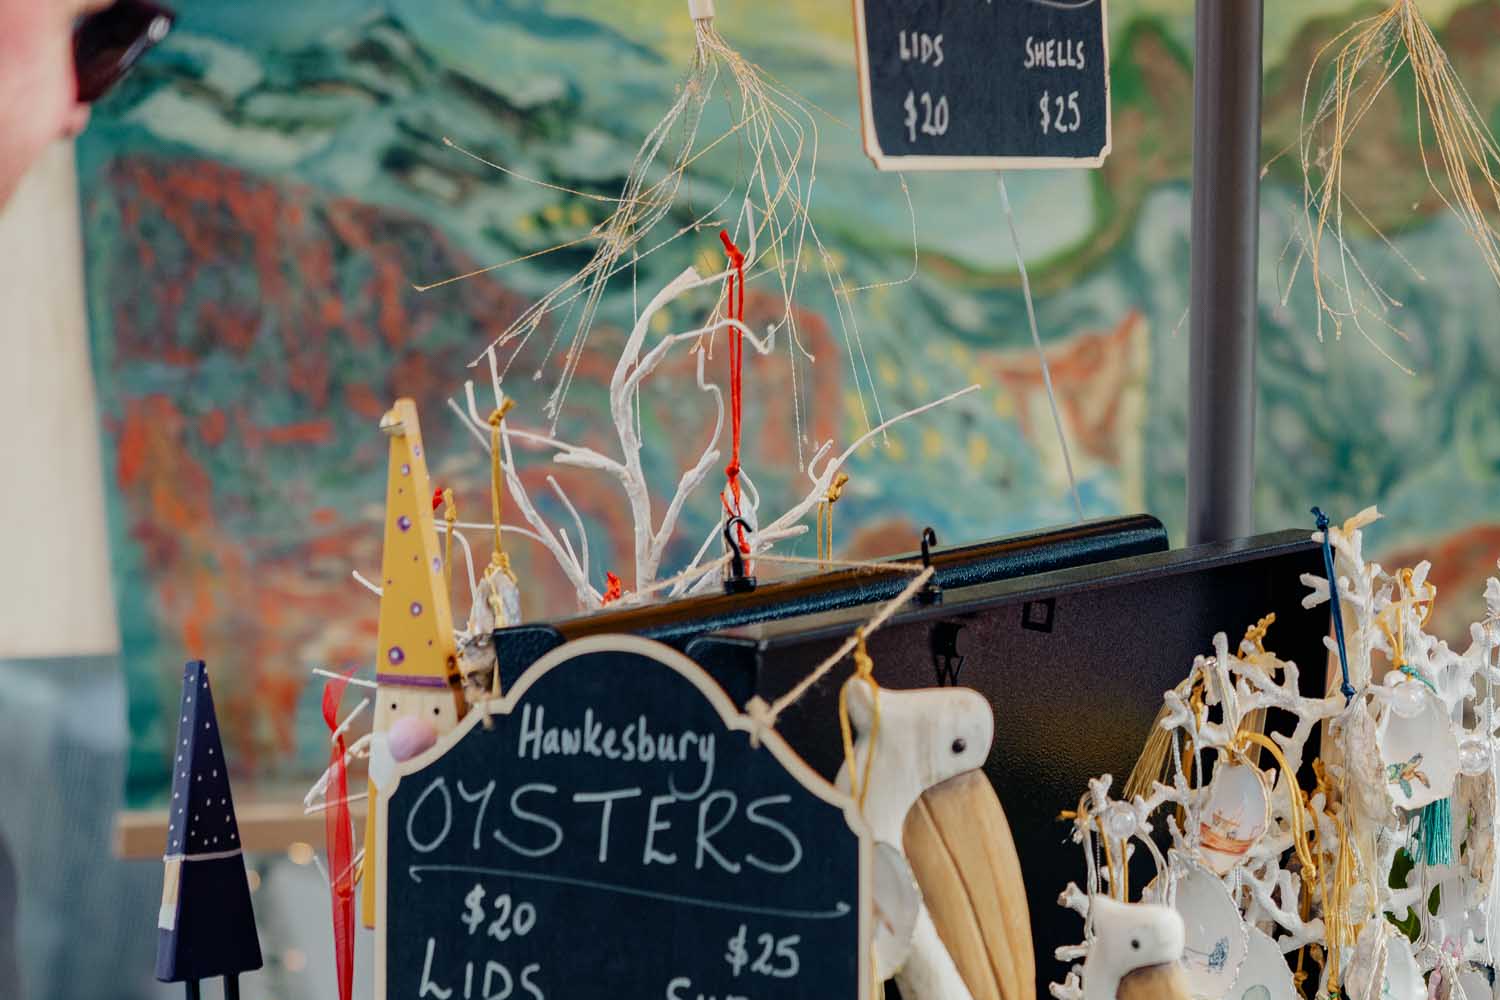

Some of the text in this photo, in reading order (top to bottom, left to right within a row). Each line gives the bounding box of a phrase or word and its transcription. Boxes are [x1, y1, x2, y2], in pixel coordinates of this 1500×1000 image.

[899, 30, 944, 67] LIDS
[1024, 36, 1085, 69] SHELLS
[904, 90, 949, 142] $20
[1040, 91, 1081, 134] $25
[518, 704, 716, 800] Hawkesbury
[407, 777, 802, 873] OYSTERS
[461, 884, 537, 940] $20
[725, 925, 801, 978] $25
